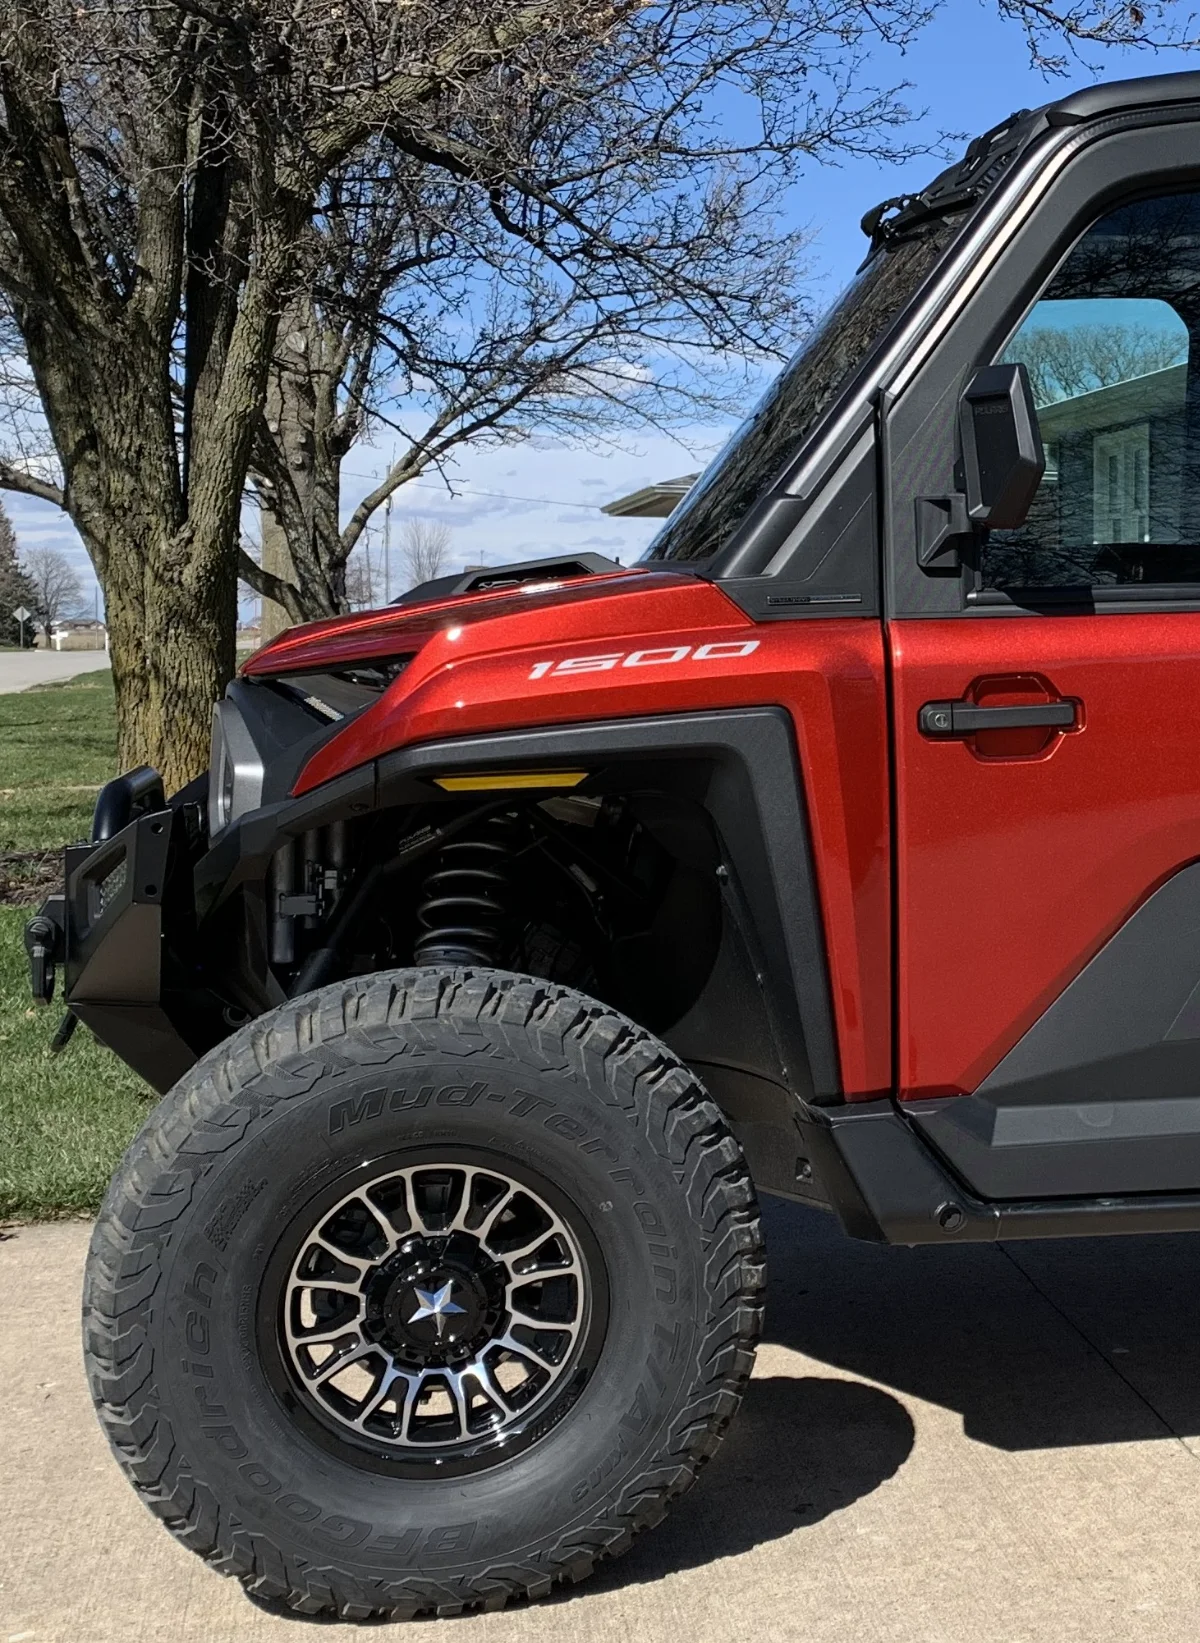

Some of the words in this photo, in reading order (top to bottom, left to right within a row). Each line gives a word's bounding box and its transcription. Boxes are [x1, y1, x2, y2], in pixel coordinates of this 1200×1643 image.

[528, 640, 761, 680] 1500
[328, 1081, 679, 1304] Mud-Terrain
[620, 1322, 681, 1436] T/A
[181, 1261, 478, 1556] BFGoodrich
